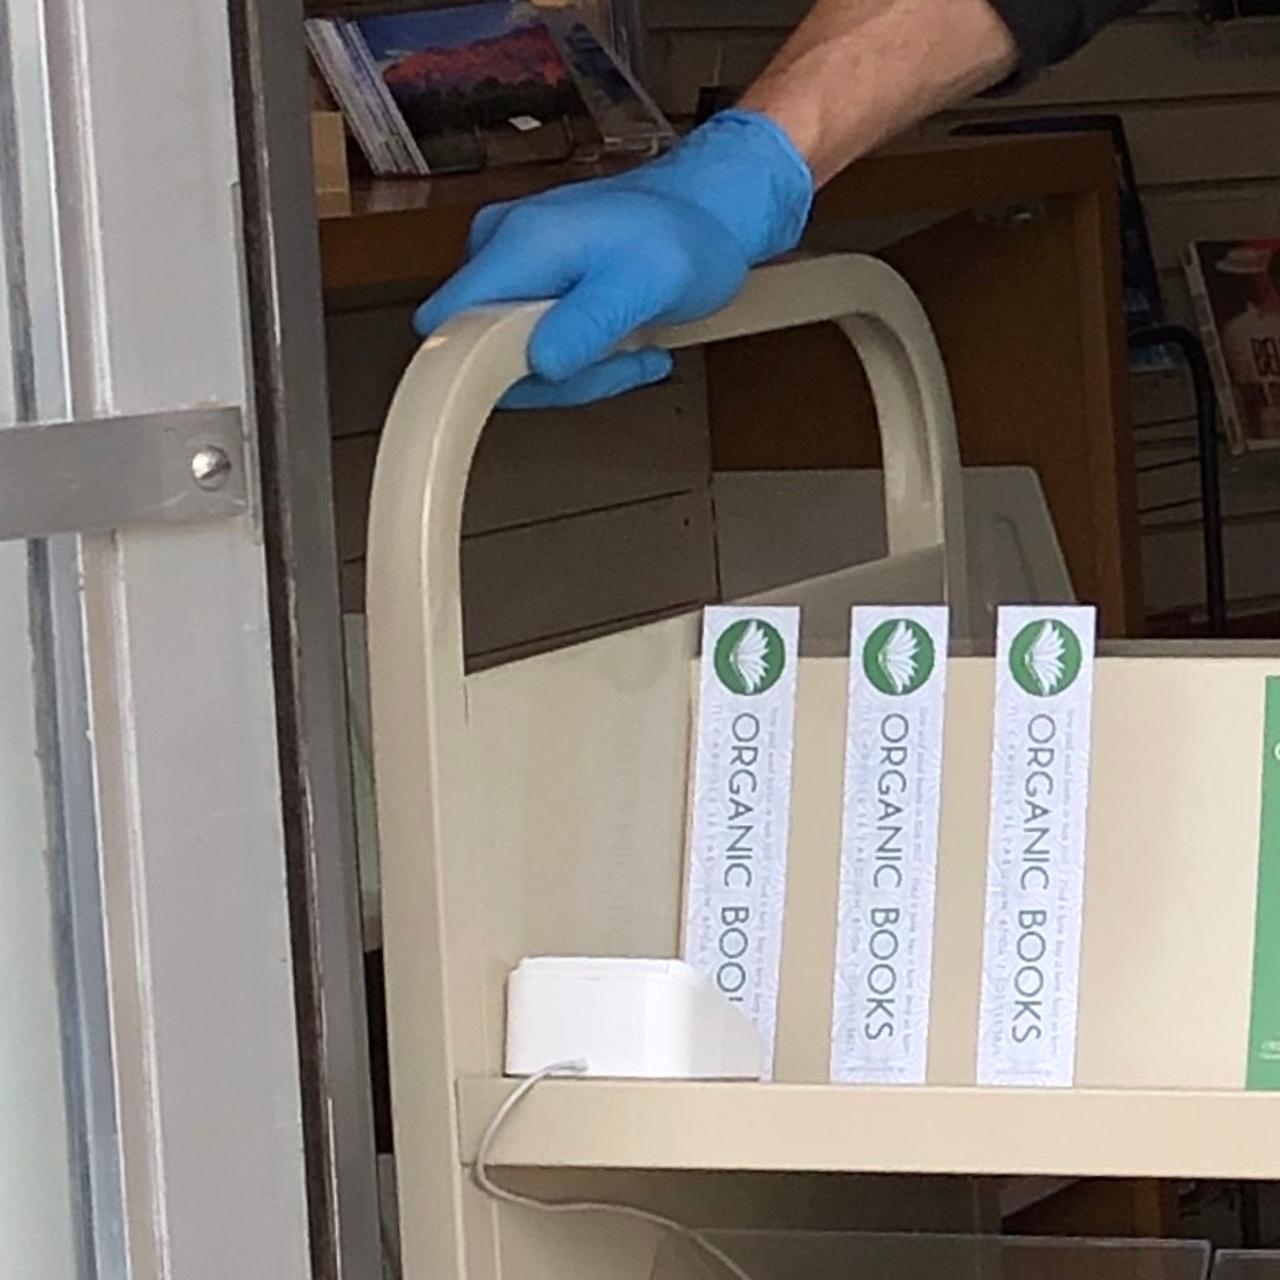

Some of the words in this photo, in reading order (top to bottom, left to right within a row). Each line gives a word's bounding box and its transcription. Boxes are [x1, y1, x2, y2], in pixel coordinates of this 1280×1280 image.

[722, 711, 761, 889] ORGANIC
[870, 711, 910, 890] ORGANIC
[1017, 711, 1056, 893] ORGANIC
[714, 905, 752, 1003] BOO
[863, 907, 900, 1042] BOOKS
[1010, 907, 1048, 1045] BOOKS
